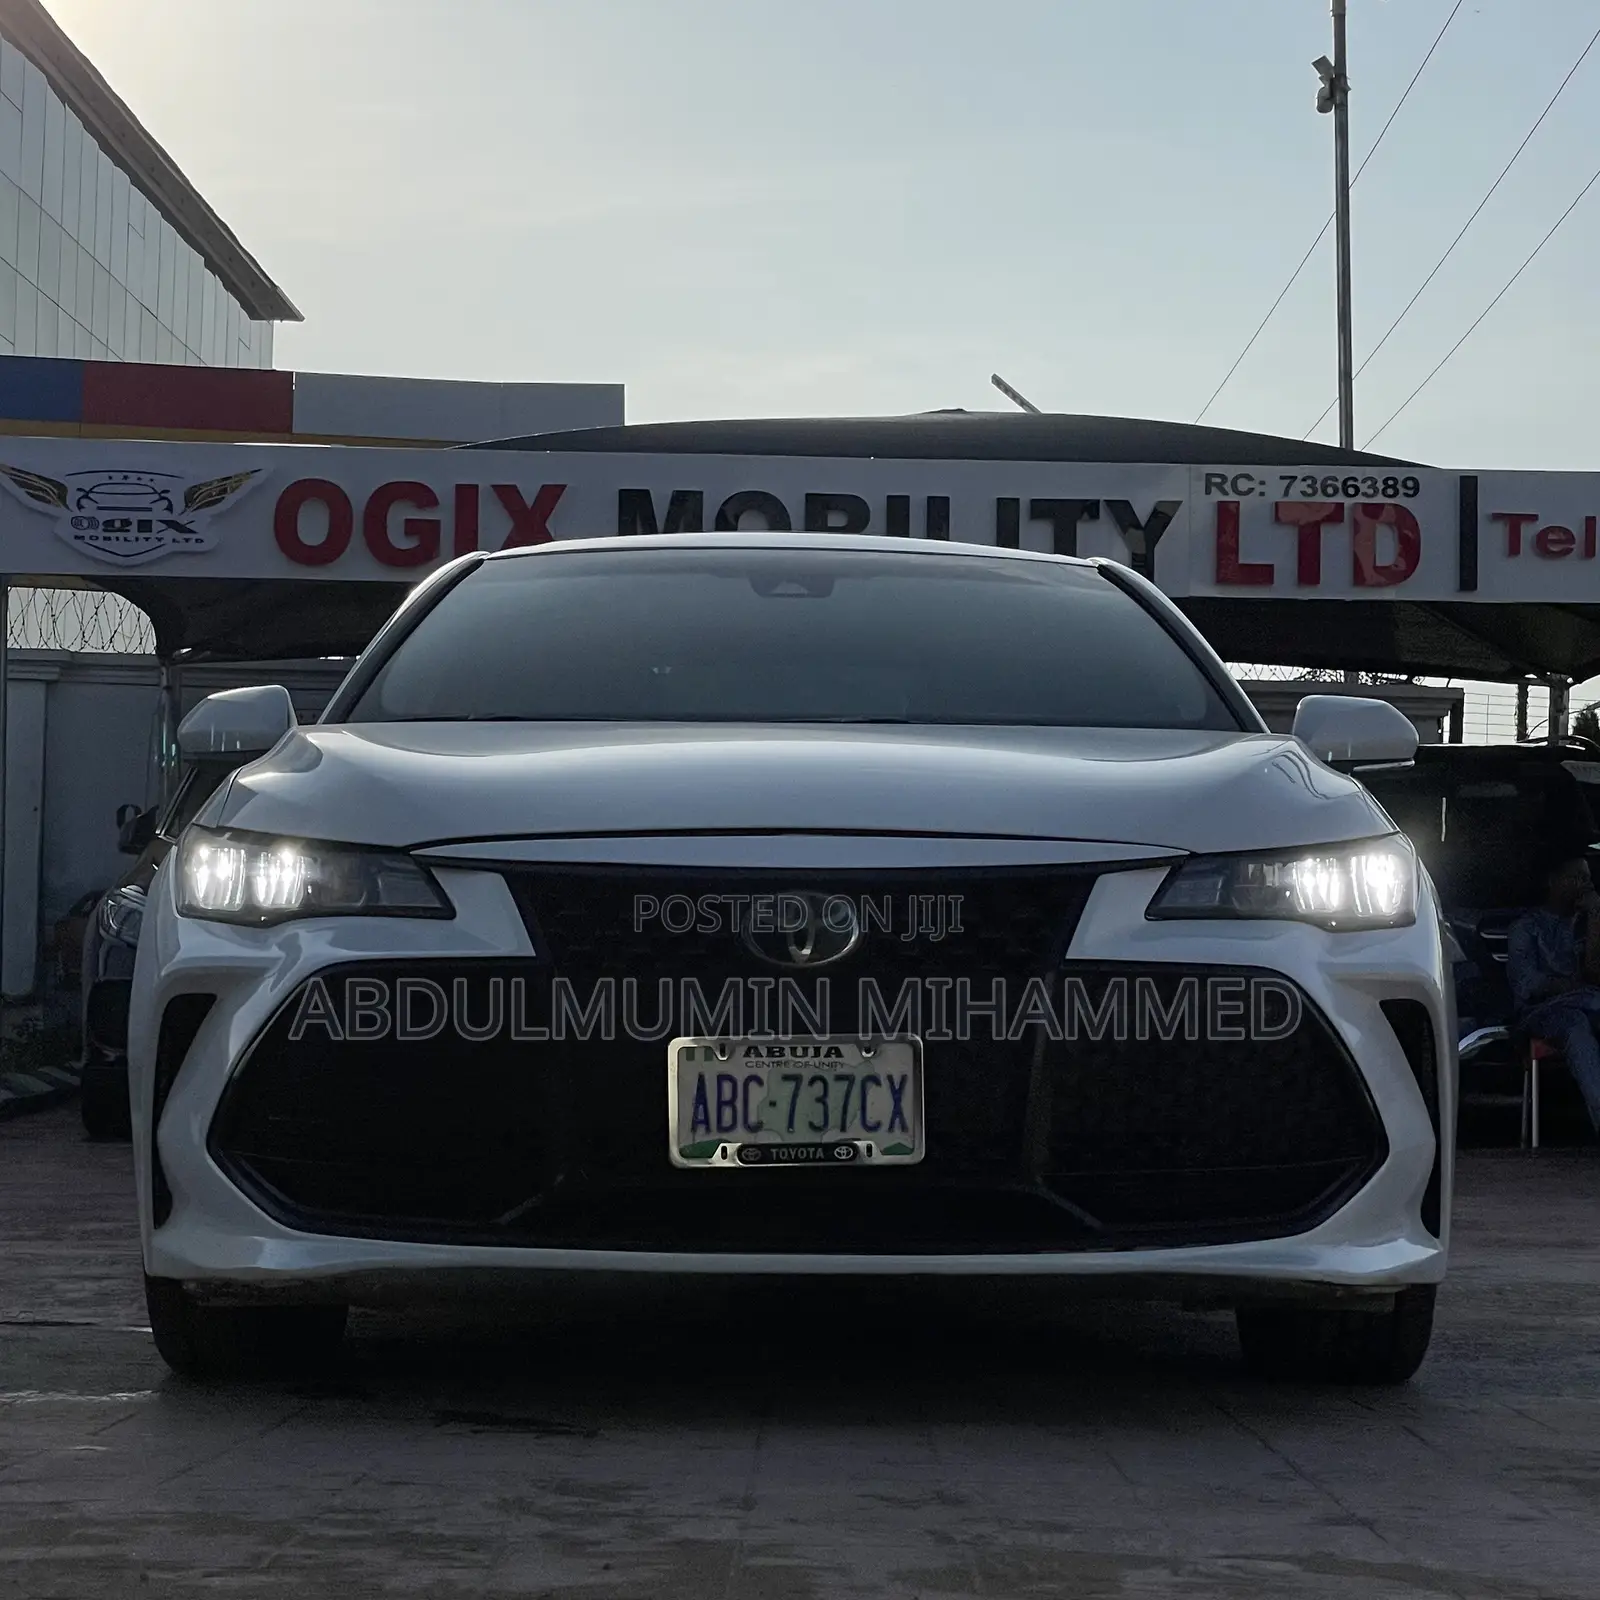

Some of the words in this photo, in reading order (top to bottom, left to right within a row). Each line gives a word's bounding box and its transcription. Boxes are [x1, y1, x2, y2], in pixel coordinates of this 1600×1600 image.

[1204, 473, 1266, 497] RC:
[1279, 475, 1420, 499] 7366389
[73, 535, 164, 543] MOBILITY
[273, 478, 567, 567] OGIX
[1216, 500, 1421, 587] LTD
[1491, 512, 1597, 559] Tel
[742, 1045, 844, 1059] ABUJA
[744, 1060, 790, 1069] CENTRE
[770, 1147, 825, 1160] TOYOTA
